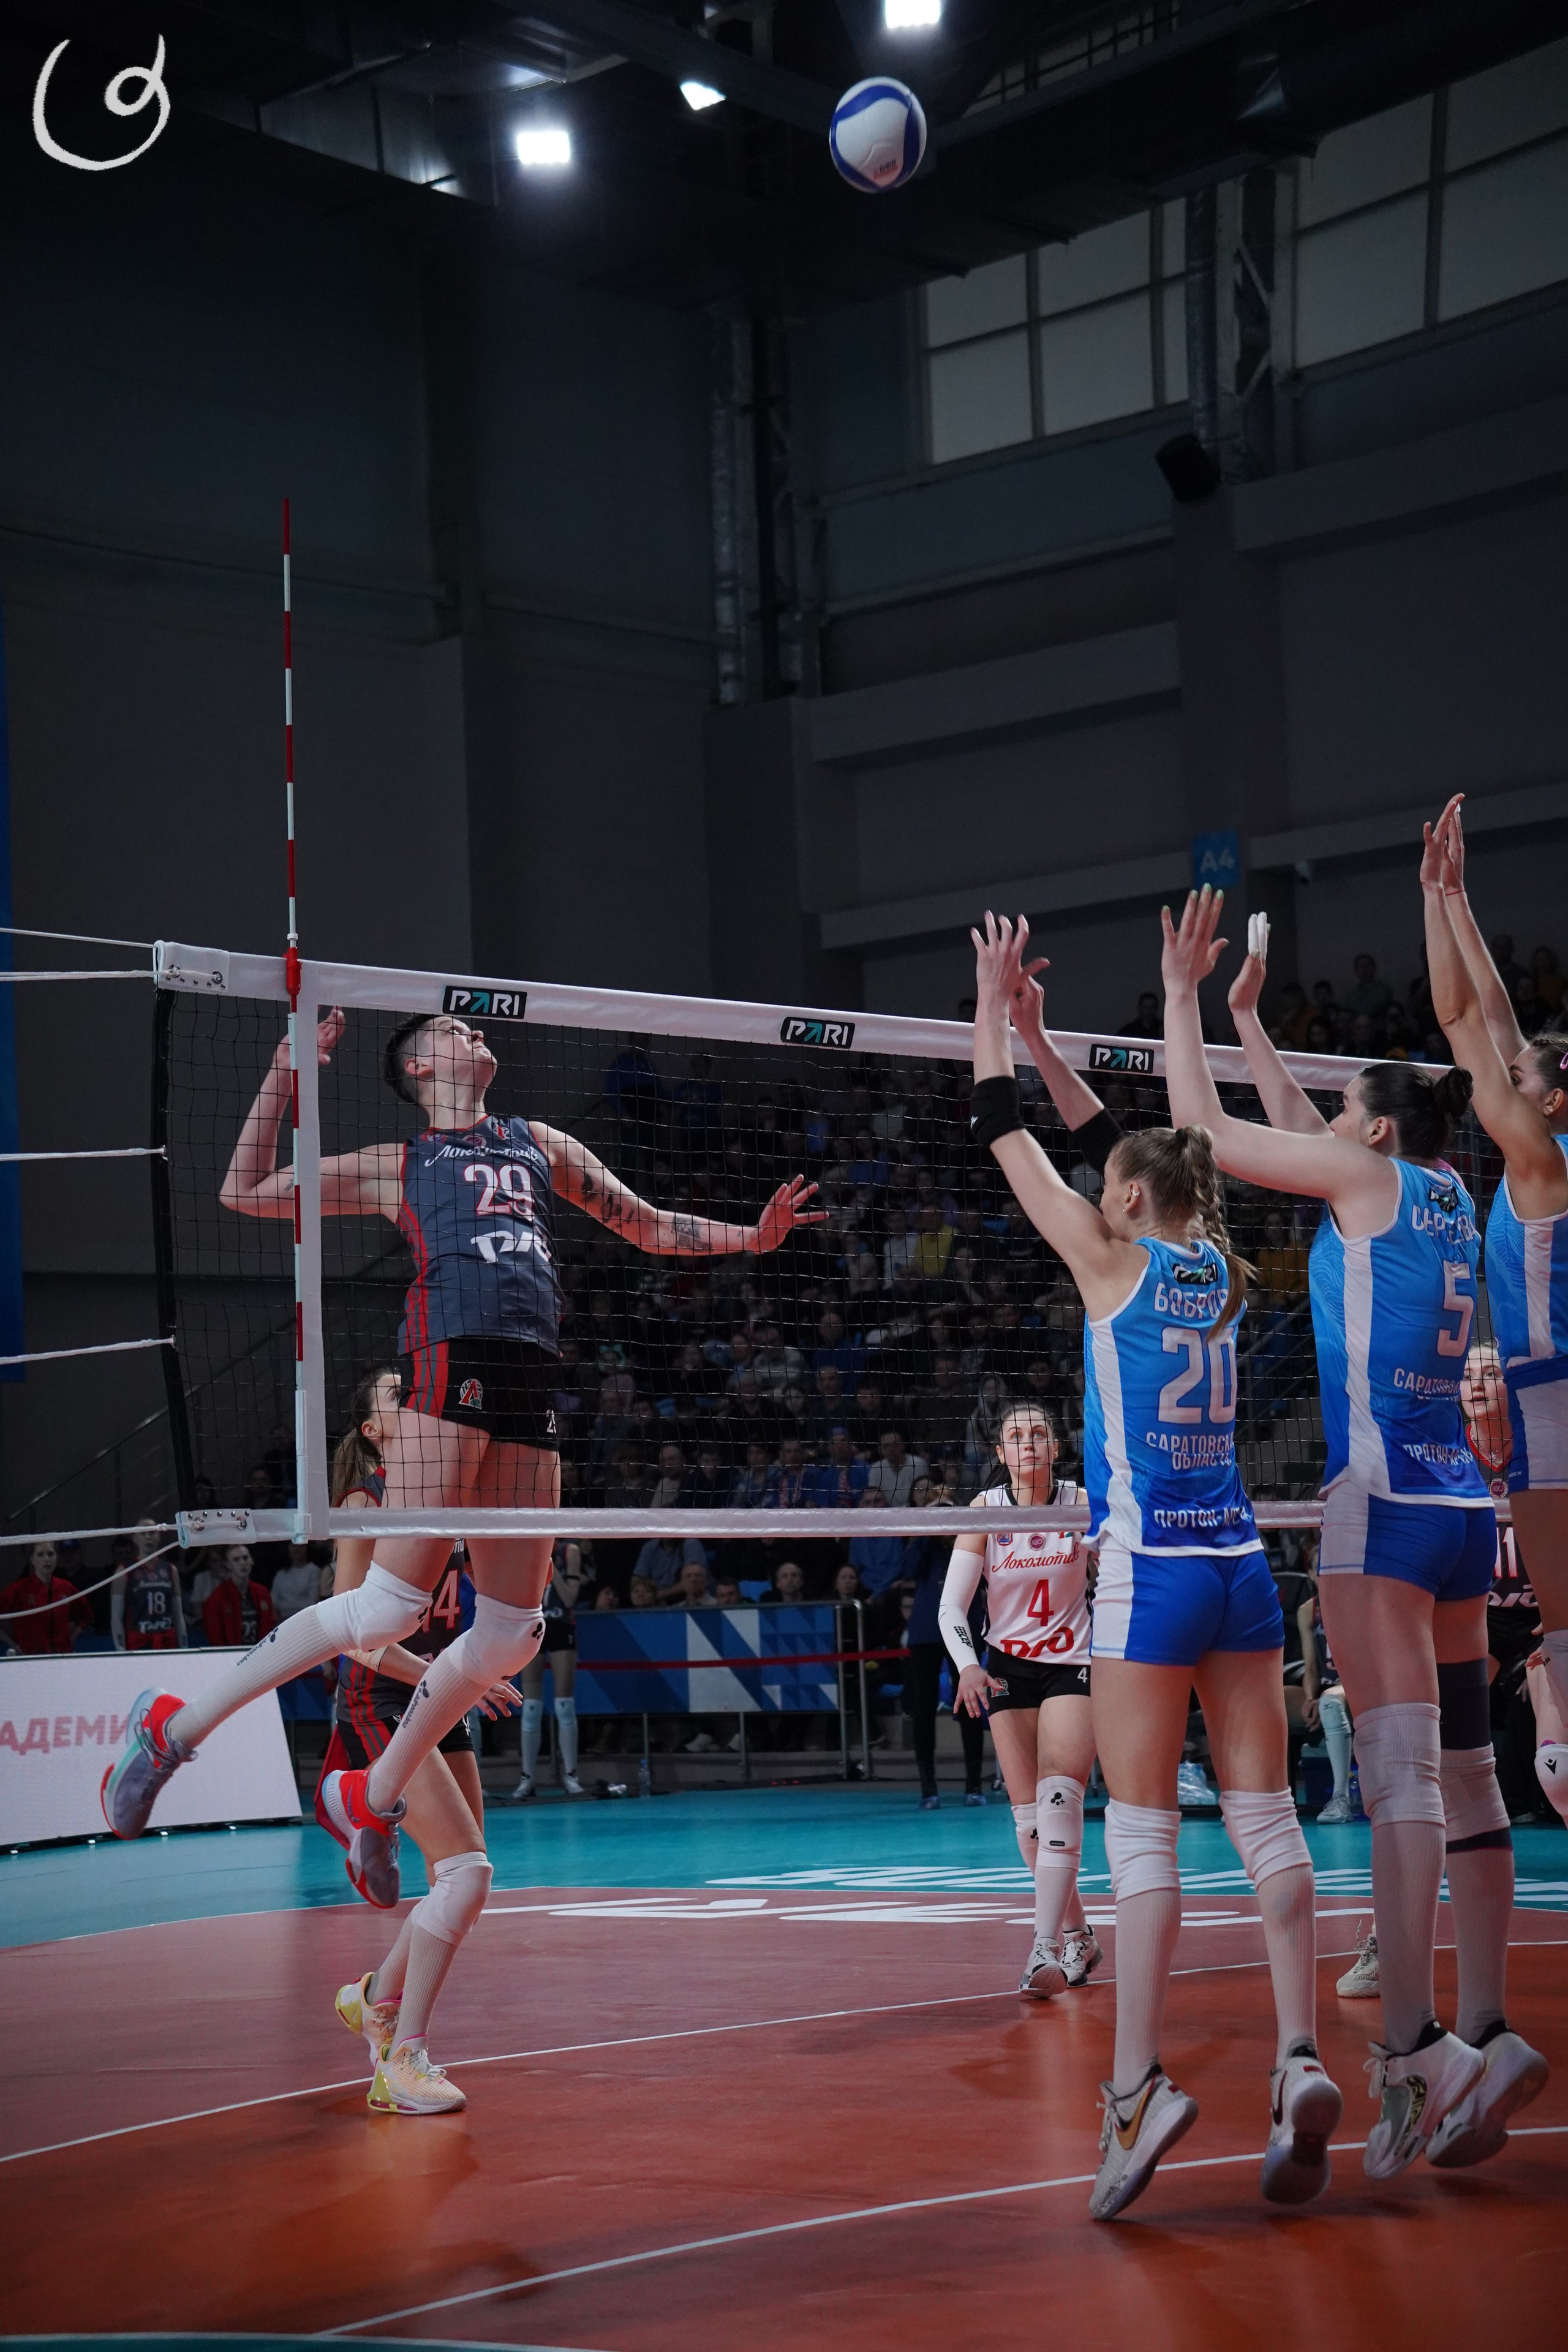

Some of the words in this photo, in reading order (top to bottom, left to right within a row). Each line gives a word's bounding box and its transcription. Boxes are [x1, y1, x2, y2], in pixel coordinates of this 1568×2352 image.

[1200, 848, 1235, 873] A4
[449, 990, 519, 1016] PARI
[786, 1020, 849, 1045] PARI
[1095, 1047, 1149, 1071] PARI
[464, 1164, 535, 1222] 29
[1437, 1260, 1474, 1357] 5
[1158, 1326, 1238, 1424] 20
[992, 1541, 1079, 1573] Локомотив
[147, 1591, 166, 1615] 18
[1027, 1579, 1054, 1627] 4
[1077, 1667, 1088, 1683] 4
